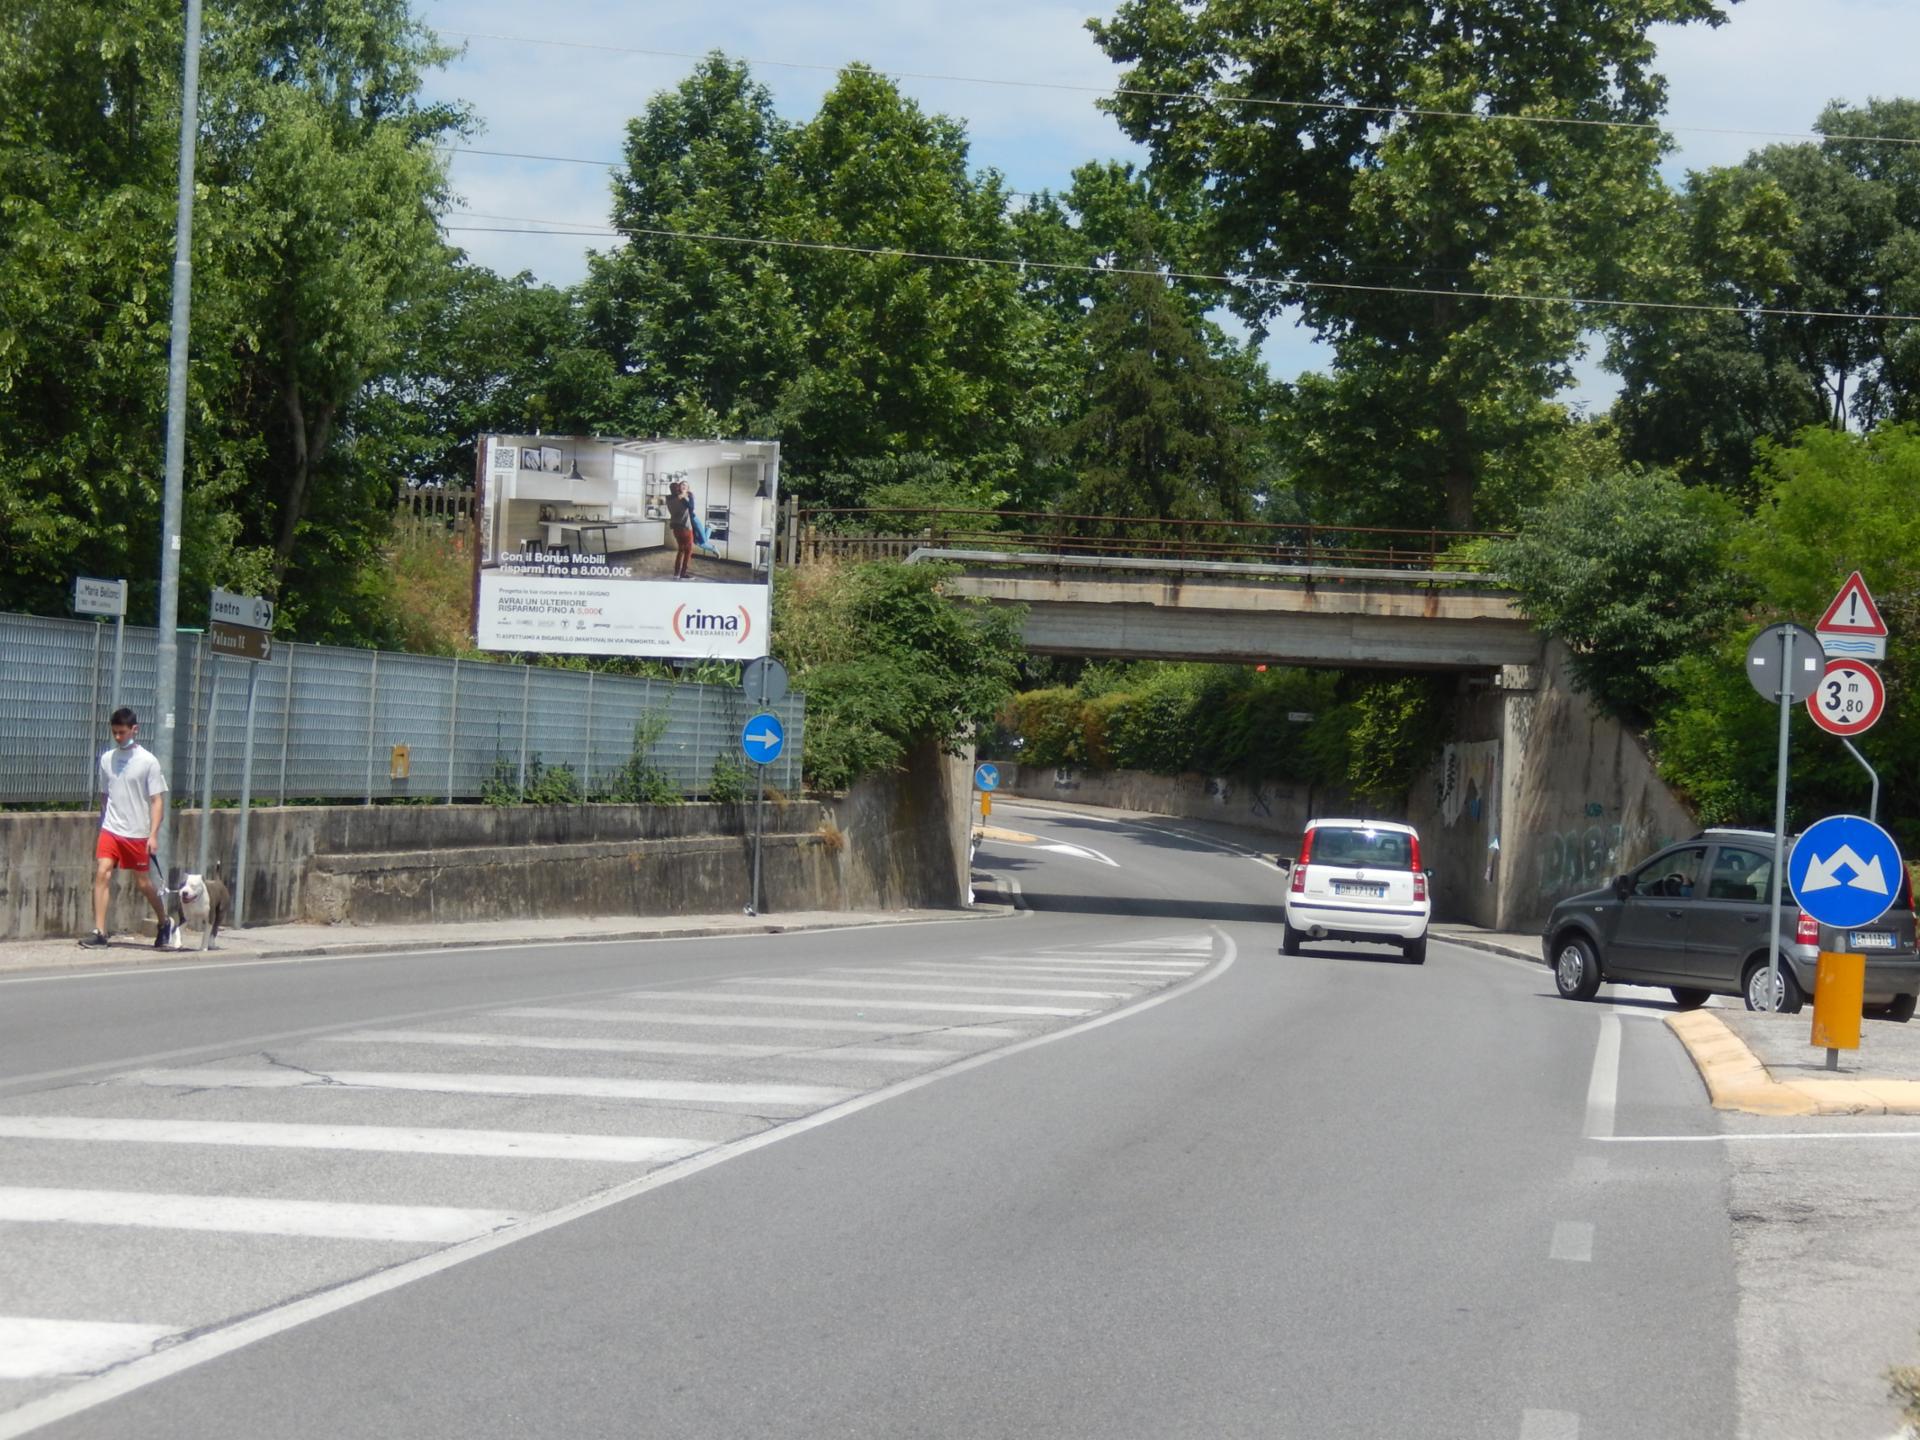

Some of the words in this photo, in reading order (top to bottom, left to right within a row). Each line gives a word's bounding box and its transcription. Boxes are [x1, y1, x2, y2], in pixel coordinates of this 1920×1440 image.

[500, 552, 522, 561] Con
[525, 552, 532, 562] il
[535, 553, 570, 563] Bonus
[572, 554, 606, 564] Mobili
[500, 564, 545, 576] risparmi
[547, 565, 569, 575] fino
[571, 567, 578, 576] a
[580, 566, 632, 577] 8.000,00€
[498, 597, 523, 605] AVRAI
[540, 598, 587, 607] ULTERIORE
[215, 602, 240, 616] centro
[498, 605, 545, 613] RISPARMIO
[547, 606, 567, 614] FINO
[685, 608, 738, 630] rima
[1848, 683, 1858, 693] m
